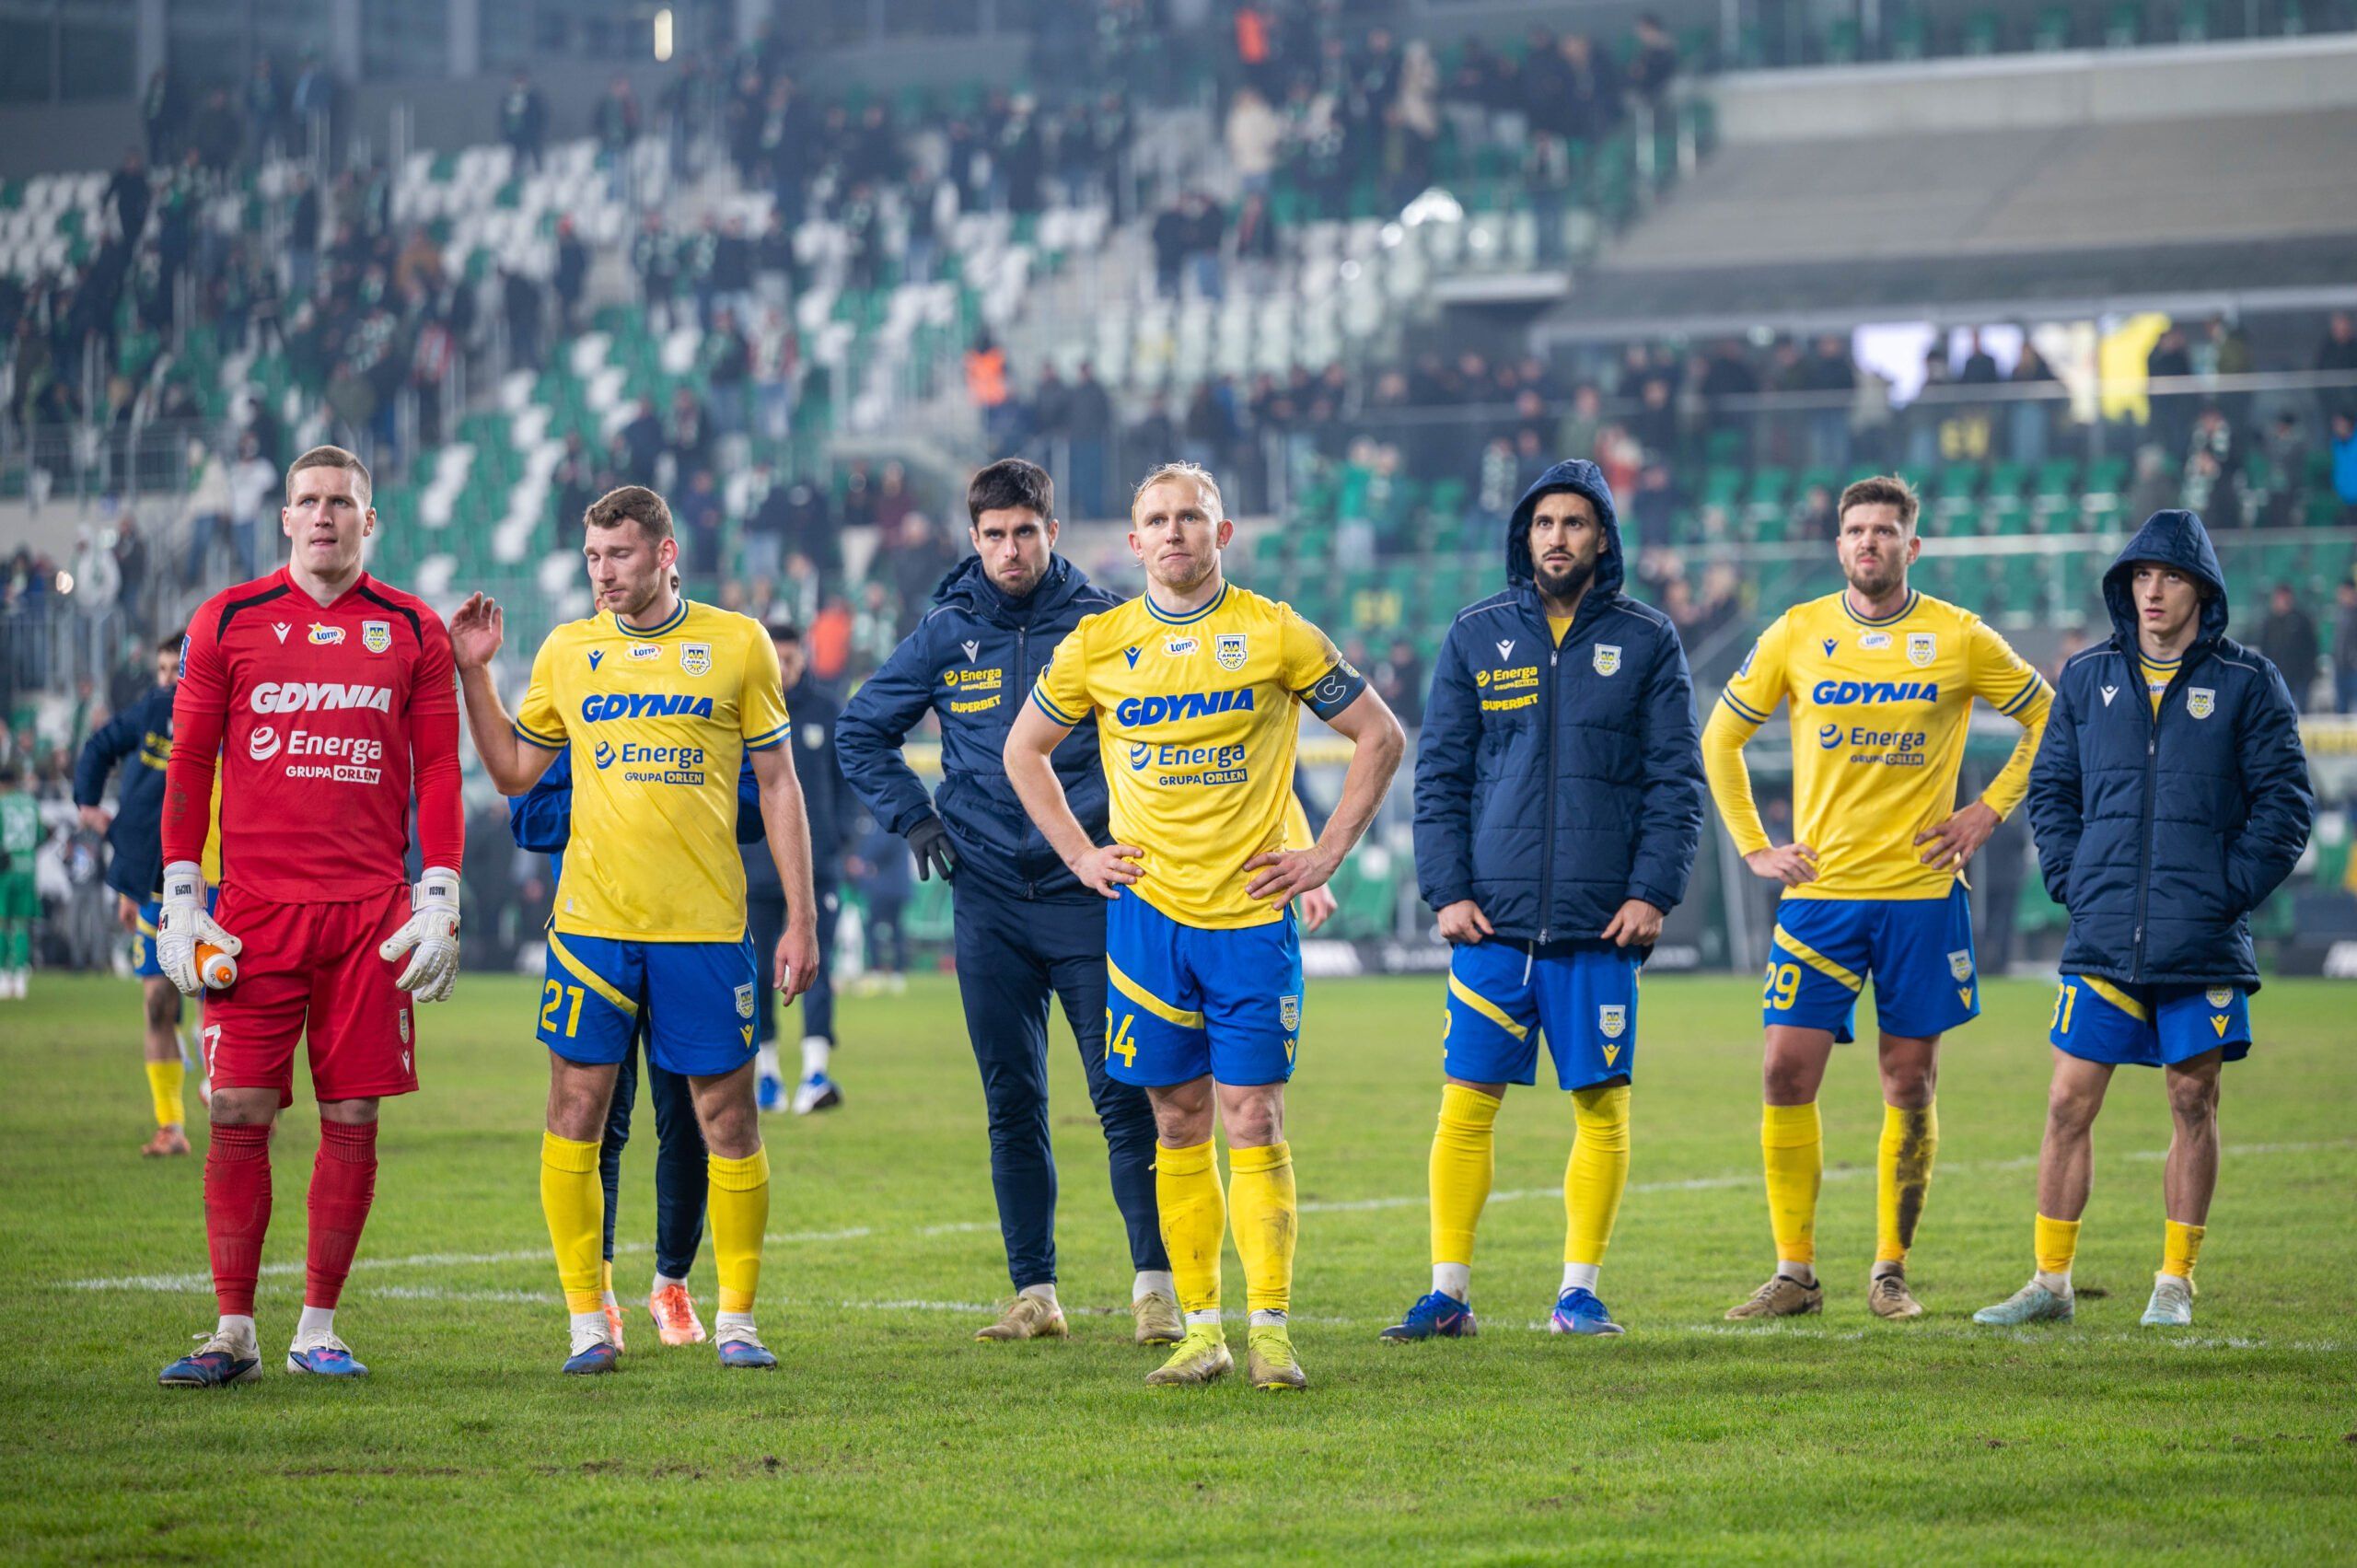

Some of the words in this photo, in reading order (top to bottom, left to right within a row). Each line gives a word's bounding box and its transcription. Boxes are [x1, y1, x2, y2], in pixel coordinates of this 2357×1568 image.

[317, 631, 338, 641] LOTTO
[1170, 641, 1192, 652] LOTTO
[633, 647, 656, 656] LOTTO
[960, 668, 1003, 682] Energa
[1493, 666, 1538, 682] Energa
[250, 681, 392, 714] GDYNIA
[1314, 675, 1346, 703] C
[1813, 680, 1939, 705] GDYNIA
[581, 693, 714, 723] GDYNIA
[950, 694, 1001, 714] SUPERBET
[1116, 688, 1255, 727] GDYNIA
[1481, 692, 1538, 712] SUPERBET
[287, 729, 382, 765] Energa
[1851, 726, 1926, 752] Energa
[621, 742, 704, 769] Energa
[1158, 742, 1247, 768] Energa
[285, 765, 332, 779] GRUPA
[336, 767, 379, 783] ORLEN
[624, 772, 663, 783] GRUPA
[666, 772, 703, 784] ORLEN
[1159, 774, 1202, 786] GRUPA
[1205, 769, 1246, 784] ORLEN
[1762, 961, 1802, 1010] 29
[540, 978, 585, 1039] 21
[203, 1024, 222, 1077] 7
